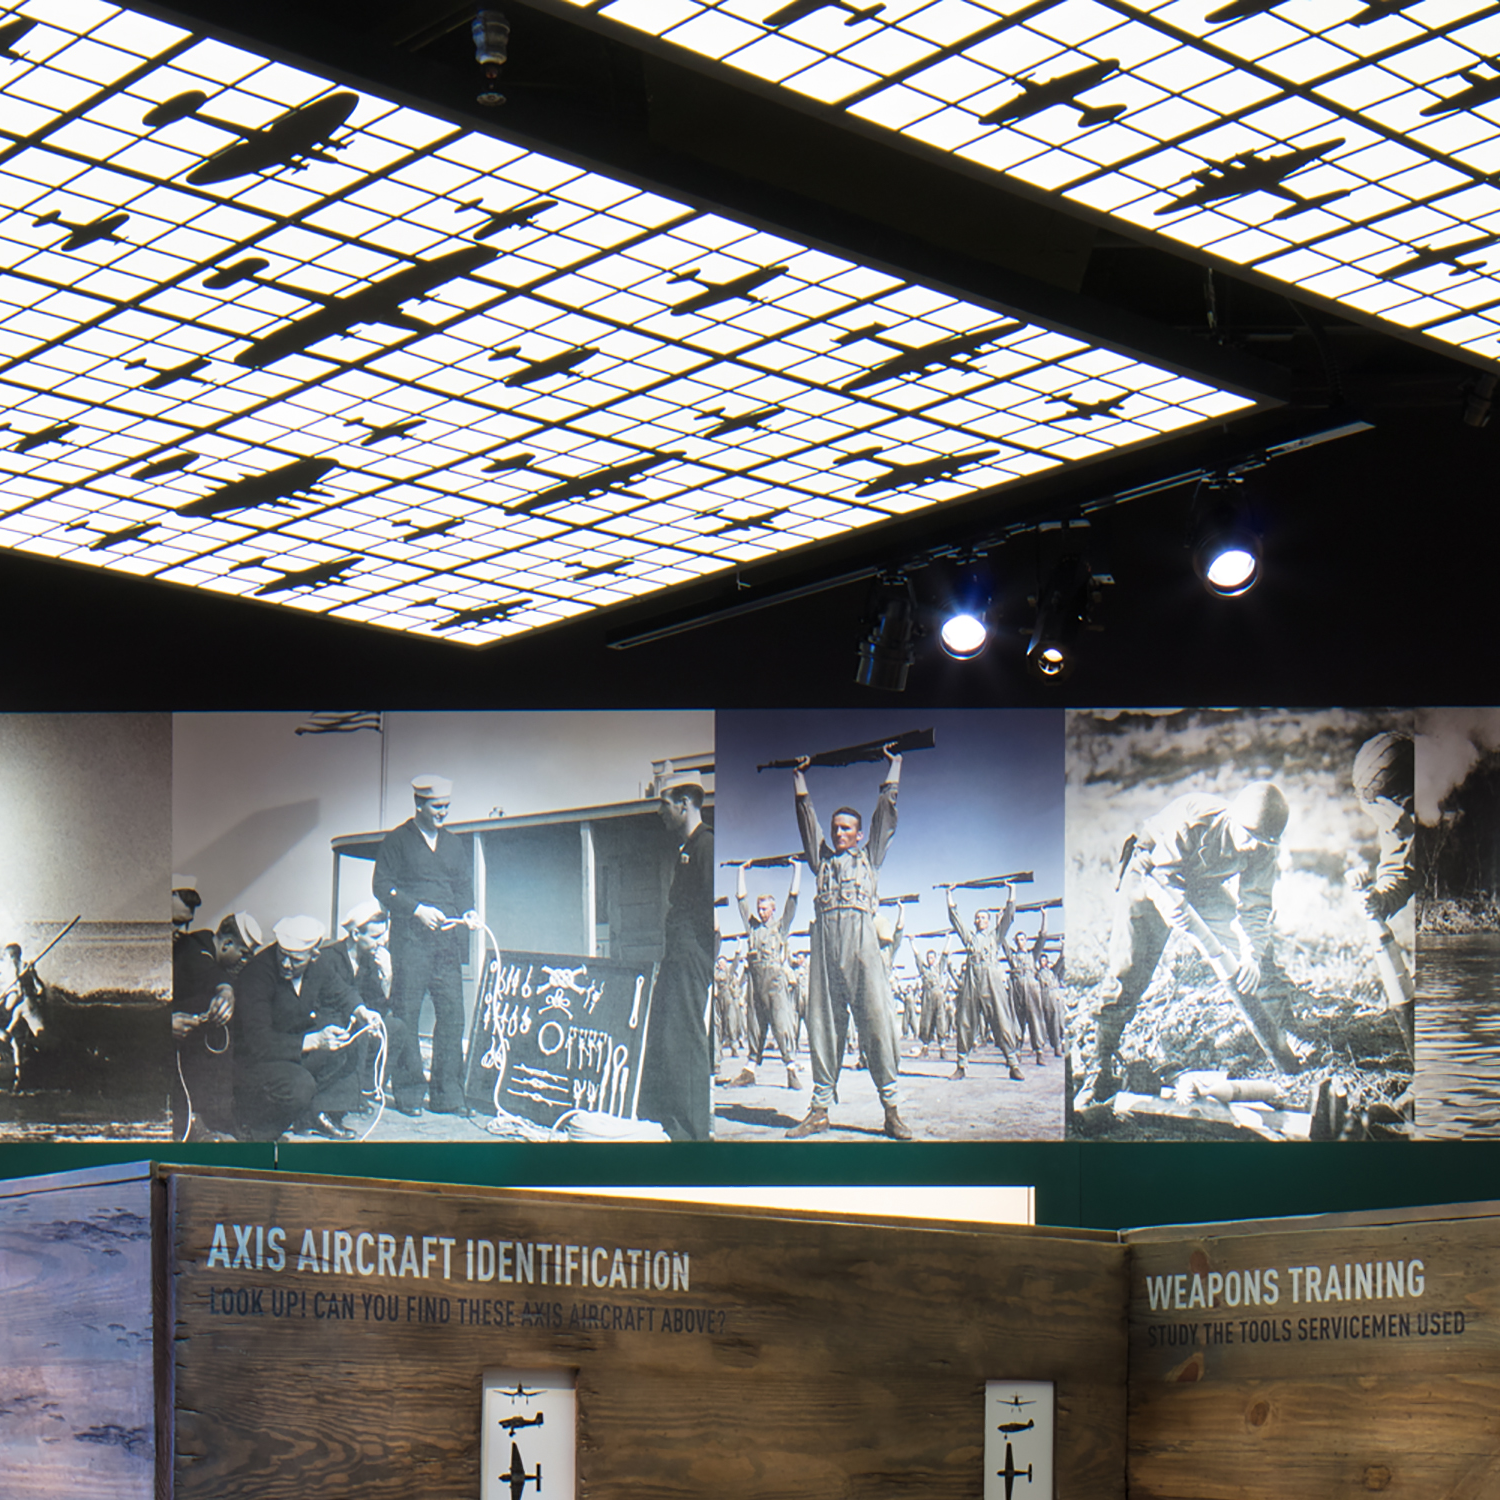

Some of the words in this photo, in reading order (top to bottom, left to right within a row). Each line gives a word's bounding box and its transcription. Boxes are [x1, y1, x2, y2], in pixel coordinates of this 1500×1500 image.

[208, 1222, 286, 1272] AXIS
[298, 1228, 456, 1280] AIRCRAFT
[466, 1238, 690, 1292] IDENTIFICATION
[1147, 1268, 1279, 1311] WEAPONS
[1288, 1259, 1425, 1303] TRAINING
[209, 1286, 264, 1316] LOOK
[271, 1288, 307, 1319] UP!
[313, 1291, 355, 1321] CAN
[362, 1293, 399, 1322] YOU
[406, 1295, 451, 1325] FIND
[458, 1297, 515, 1327] THESE
[520, 1300, 563, 1330] AXIS
[569, 1302, 655, 1334] AIRCRAFT
[661, 1306, 728, 1337] ABOVE?
[1148, 1322, 1199, 1347] STUDY
[1203, 1320, 1233, 1345] THE
[1237, 1317, 1293, 1343] TOOLS
[1298, 1312, 1410, 1341] SERVICEMEN
[1417, 1310, 1465, 1336] USED
